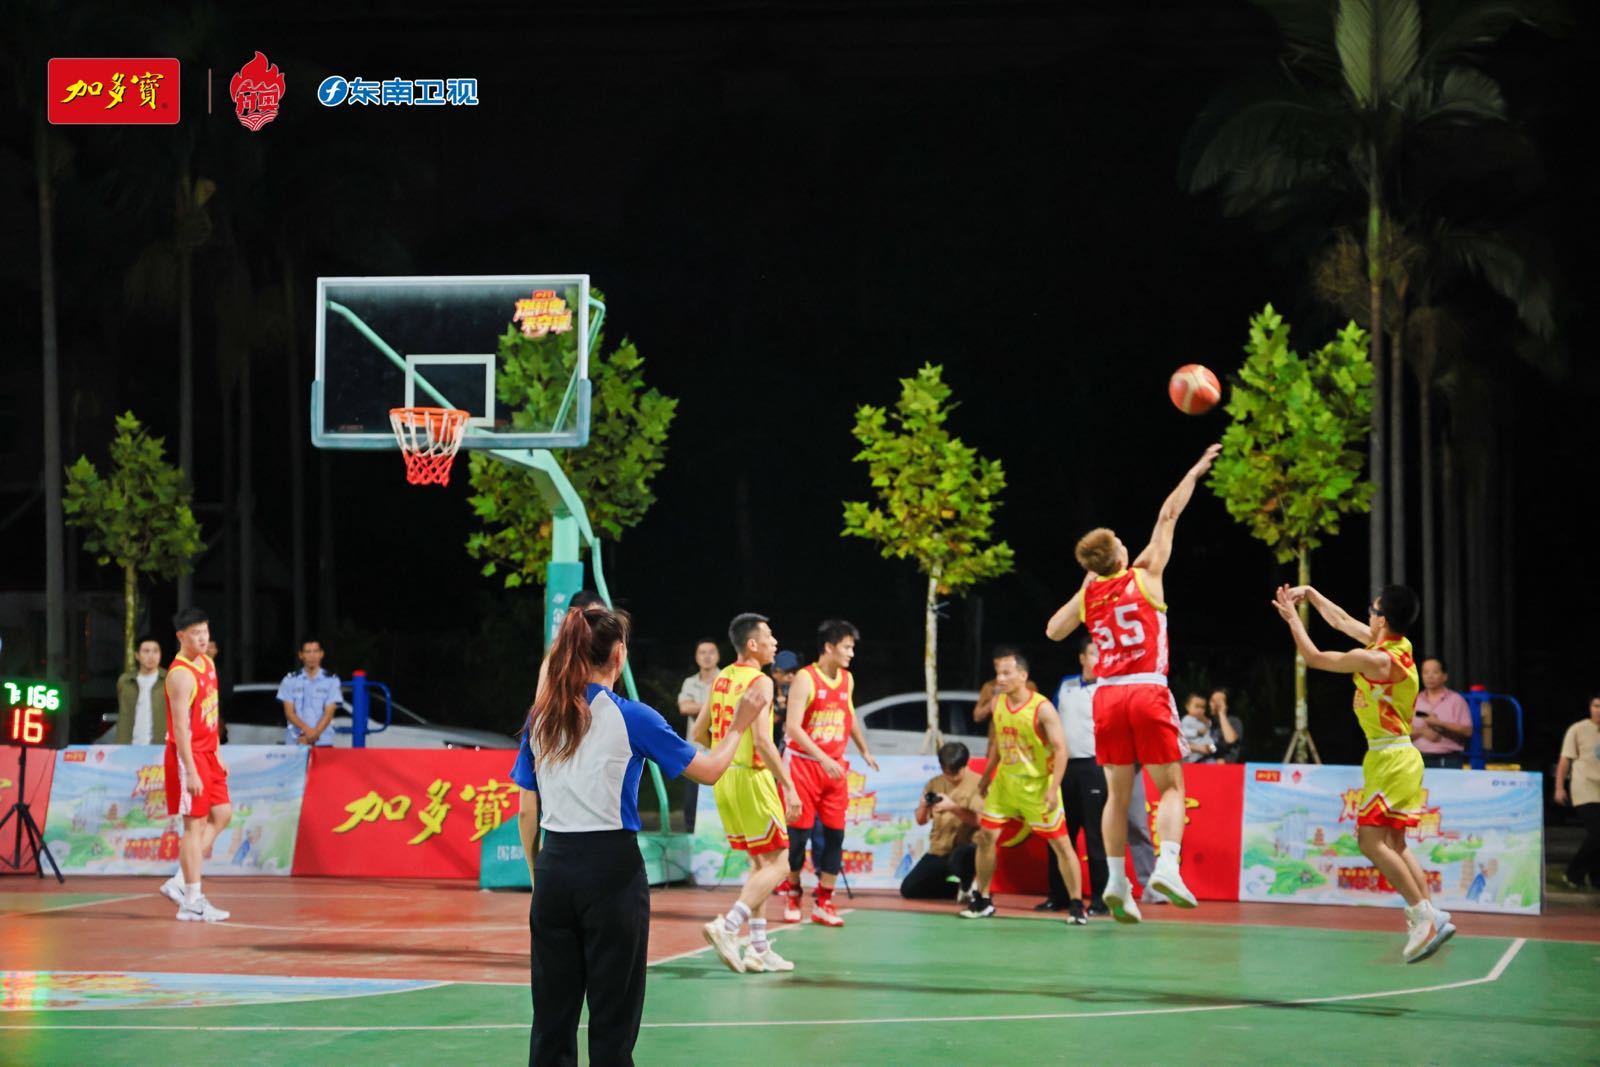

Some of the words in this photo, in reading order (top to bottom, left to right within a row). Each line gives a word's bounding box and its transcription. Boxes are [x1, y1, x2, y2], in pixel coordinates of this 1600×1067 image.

[1092, 602, 1146, 650] 55
[13, 708, 43, 743] 16
[332, 778, 520, 845] 加多寶
